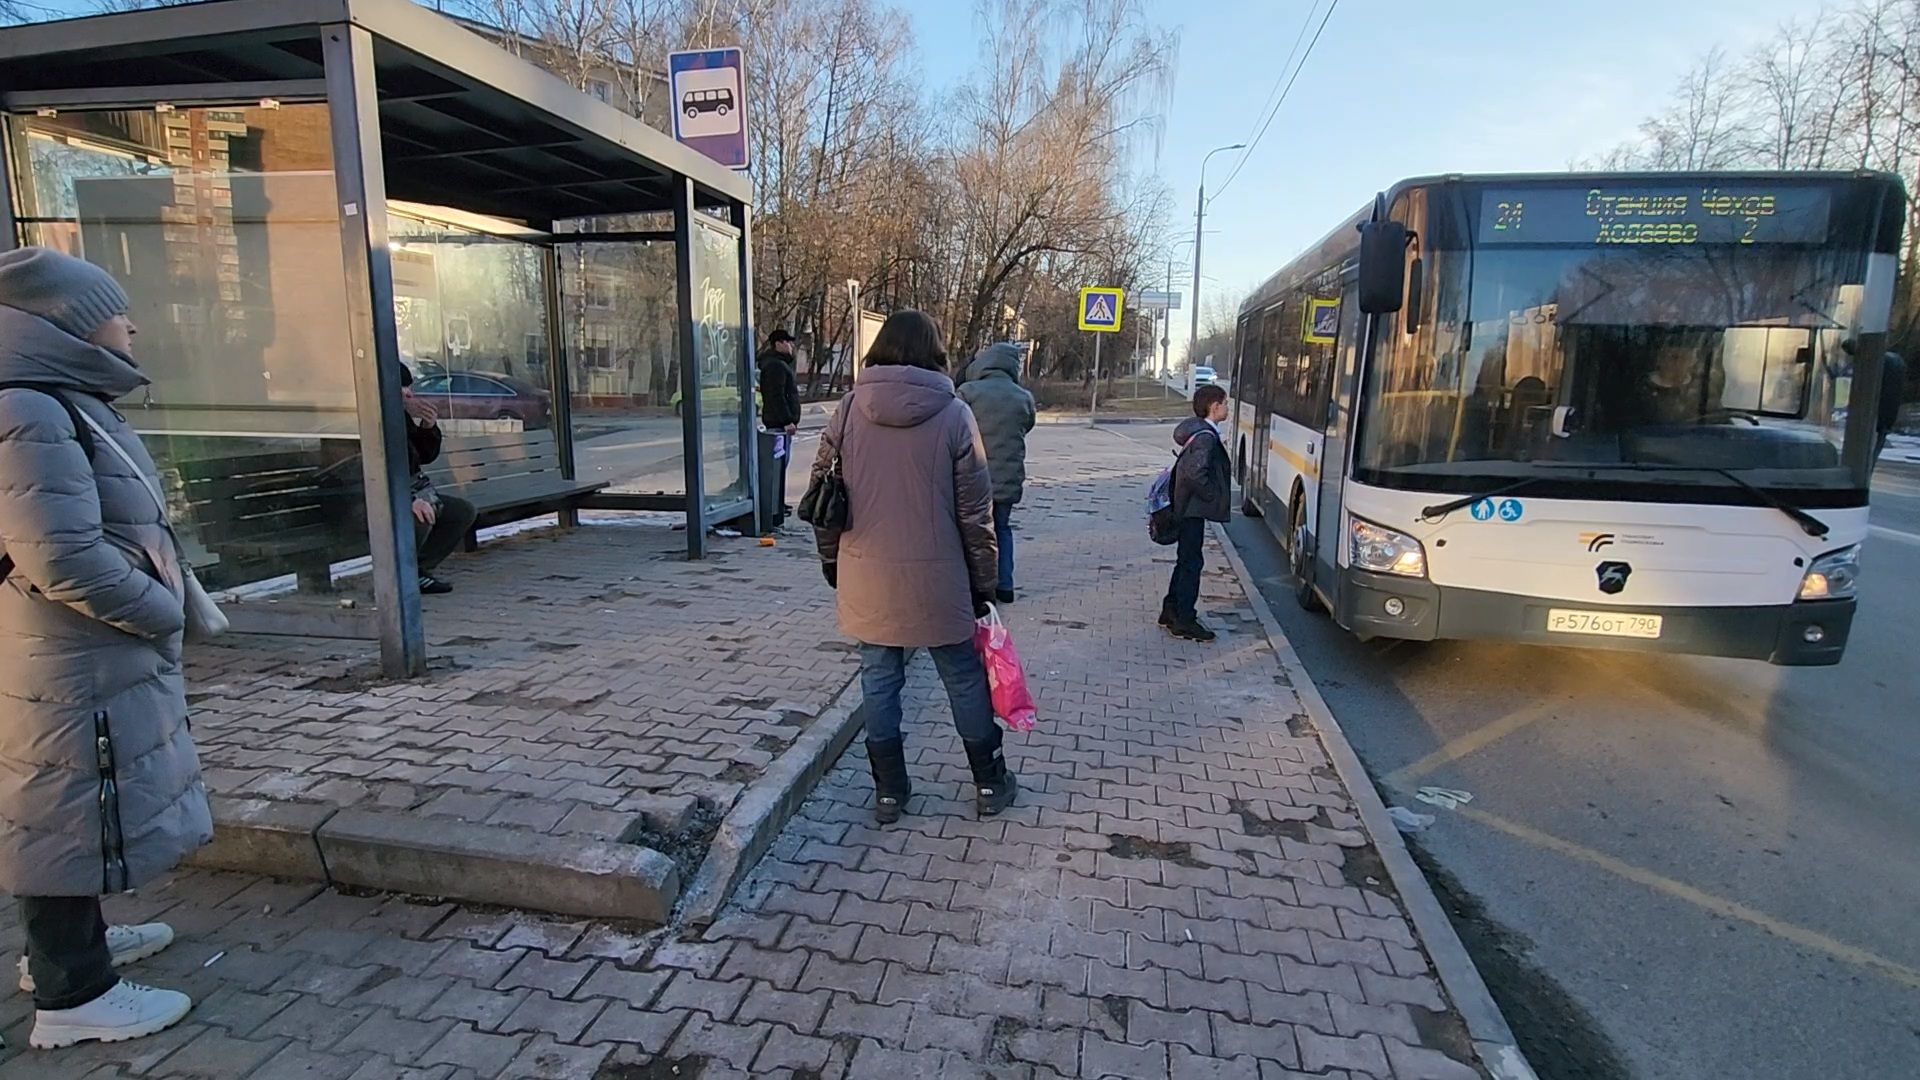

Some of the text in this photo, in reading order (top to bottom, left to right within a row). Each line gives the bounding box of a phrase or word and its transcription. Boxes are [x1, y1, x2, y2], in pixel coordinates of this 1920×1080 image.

[1586, 188, 1775, 215] Станция Чехов
[1596, 216, 1758, 243] Ходаево 2
[1630, 617, 1655, 630] 790
